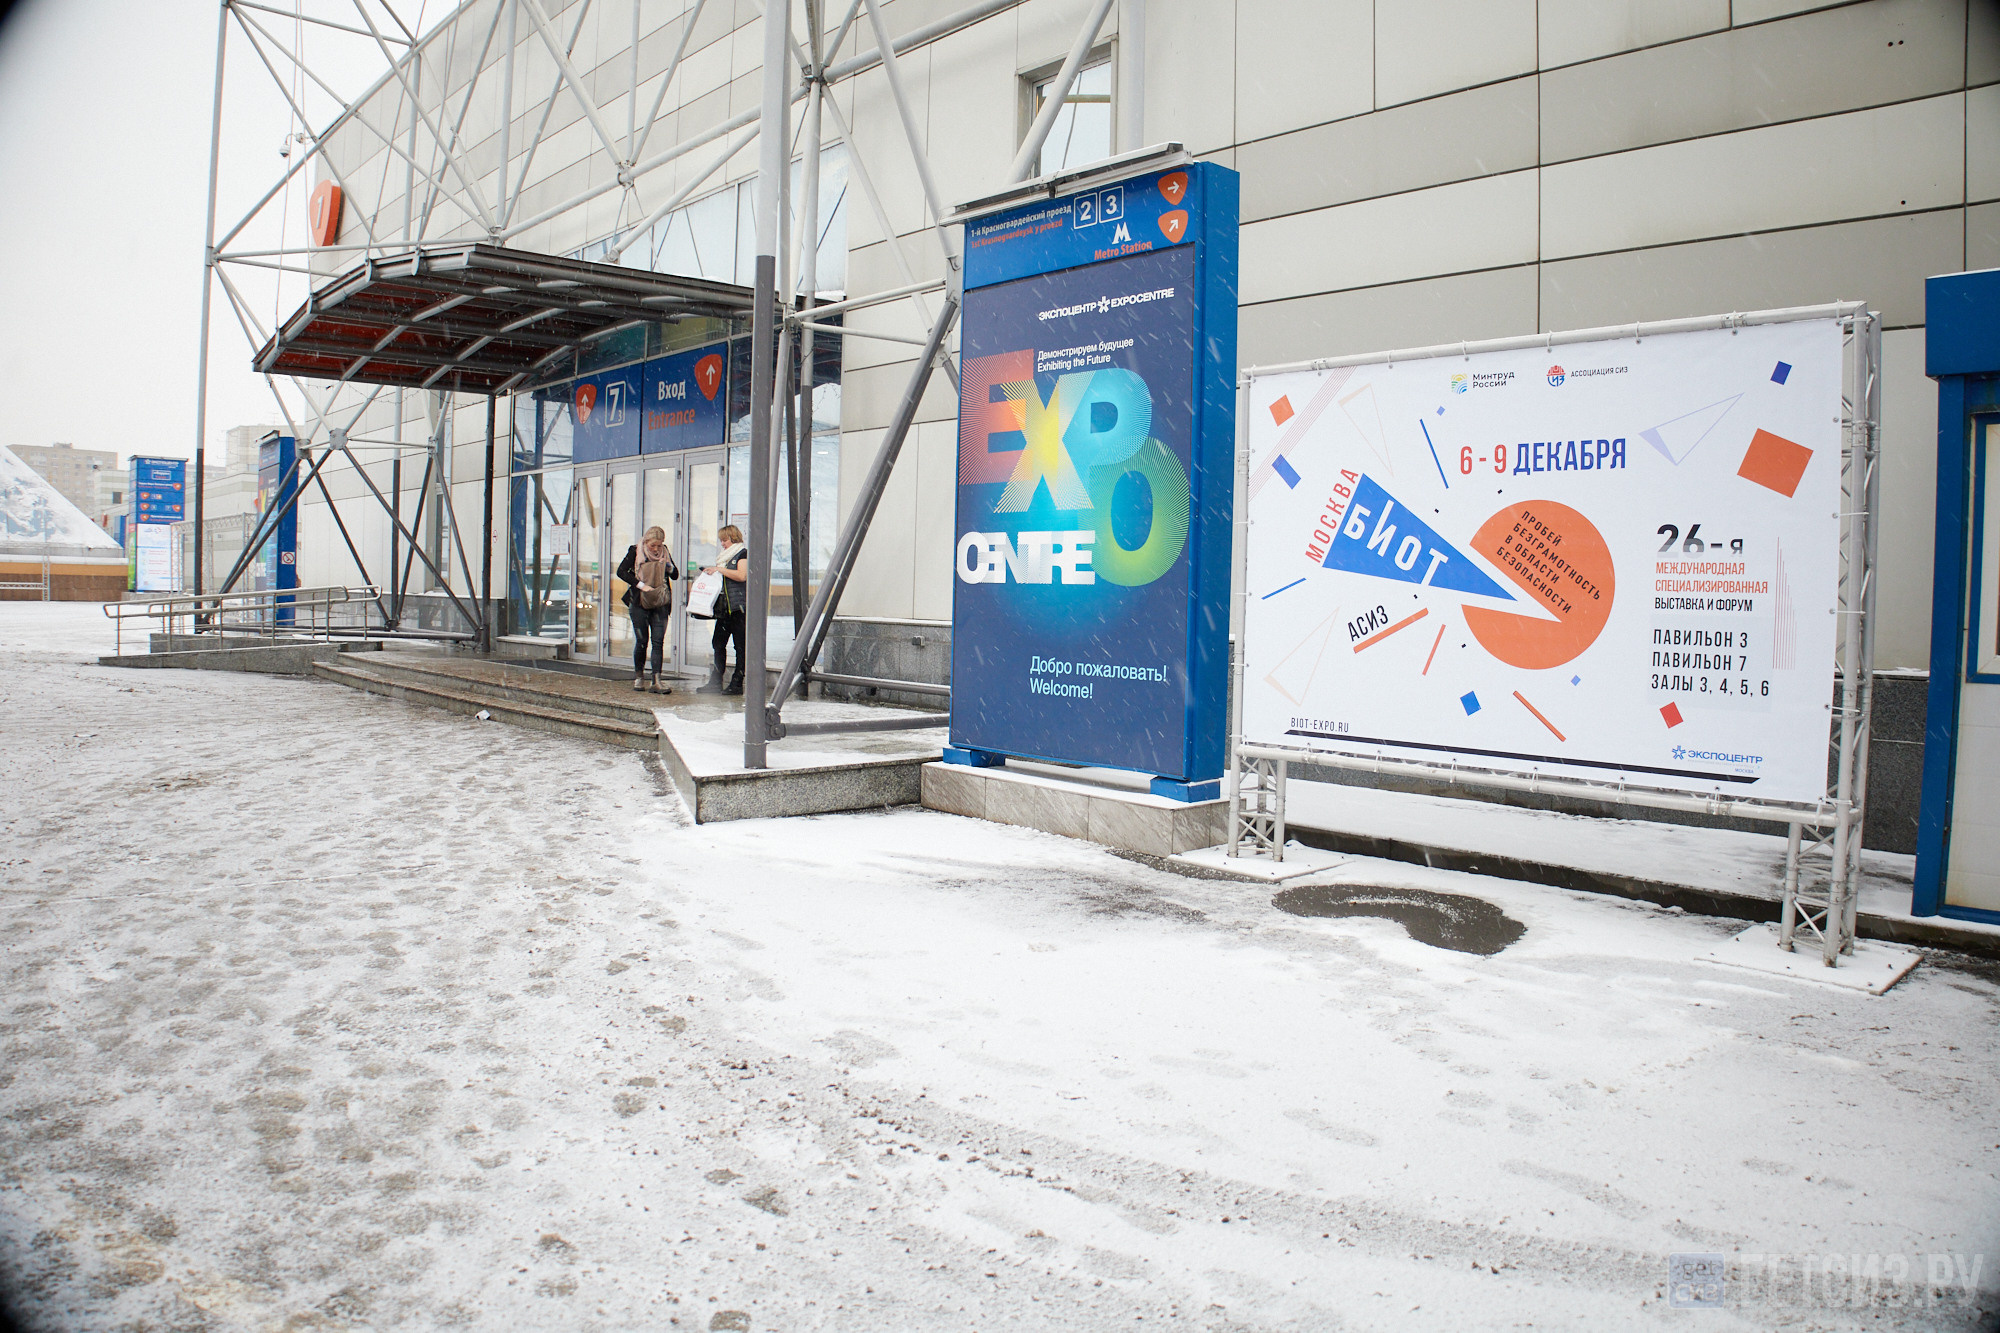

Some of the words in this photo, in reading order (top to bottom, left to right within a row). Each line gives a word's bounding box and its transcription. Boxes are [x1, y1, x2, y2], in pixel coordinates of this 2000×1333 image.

[315, 195, 324, 229] 1
[1080, 200, 1092, 222] 2
[1105, 194, 1118, 215] 3
[970, 228, 981, 238] 1-й
[981, 211, 1046, 236] Красногвардейский
[1046, 204, 1072, 219] проезд
[971, 239, 981, 249] 1st
[1039, 217, 1063, 233] proezd
[1094, 246, 1119, 261] Metro
[1120, 240, 1152, 256] Station
[1111, 287, 1175, 308] EXPOCENTRE
[1038, 302, 1097, 321] ЭКСПОЦЕНТР
[1037, 344, 1098, 362] Демонстрируем
[1099, 338, 1134, 353] будущее
[1037, 358, 1071, 373] Exhibiting
[1073, 356, 1085, 367] the
[1086, 353, 1111, 366] Future
[1570, 367, 1614, 378] АССОЦИАЦИЯ
[1615, 366, 1628, 374] СИЗ
[1472, 371, 1515, 381] Минтруд
[1472, 380, 1507, 388] России
[657, 379, 686, 400] Вход
[609, 387, 619, 422] 7
[648, 408, 696, 431] Entrance
[1513, 438, 1626, 476] ДЕКАБРЯ
[1305, 468, 1359, 564] МОСКВА
[1521, 510, 1562, 547] ПРОБЕЙ
[1342, 499, 1449, 586] БИОТ
[956, 530, 1096, 585] CENTRE
[1504, 534, 1513, 544] В
[1514, 543, 1560, 584] ОБЛАСТИ
[1513, 523, 1601, 601] БЕЗГРАМОТНОСТЬ
[1655, 562, 1745, 576] МЕЖДУНАРОДНАЯ
[1496, 546, 1572, 614] БЕЗОПАСНОСТИ
[1655, 579, 1768, 594] СПЕЦИАЛИЗИРОВАННАЯ
[1654, 597, 1704, 611] ВЫСТАВКА
[1707, 598, 1714, 611] И
[1715, 598, 1753, 612] ФОРУМ
[1347, 605, 1389, 642] АСИЗ
[1653, 629, 1733, 648] ПАВИЛЬОН
[1739, 632, 1748, 648] 3
[1030, 655, 1073, 678] Добро
[1076, 662, 1168, 682] пожаловать!
[1652, 651, 1732, 671] ПАВИЛЬОН
[1739, 655, 1747, 671] 7
[1029, 677, 1094, 699] Welcome!
[1651, 674, 1693, 692] ЗАЛЫ
[1699, 676, 1712, 695] 3,
[1719, 678, 1733, 697] 4,
[1740, 679, 1753, 698] 5,
[1761, 680, 1769, 696] 6
[1290, 717, 1349, 733] BIOT-EXPO.RU
[1687, 750, 1763, 764] ЭКСПОЦЕНТР
